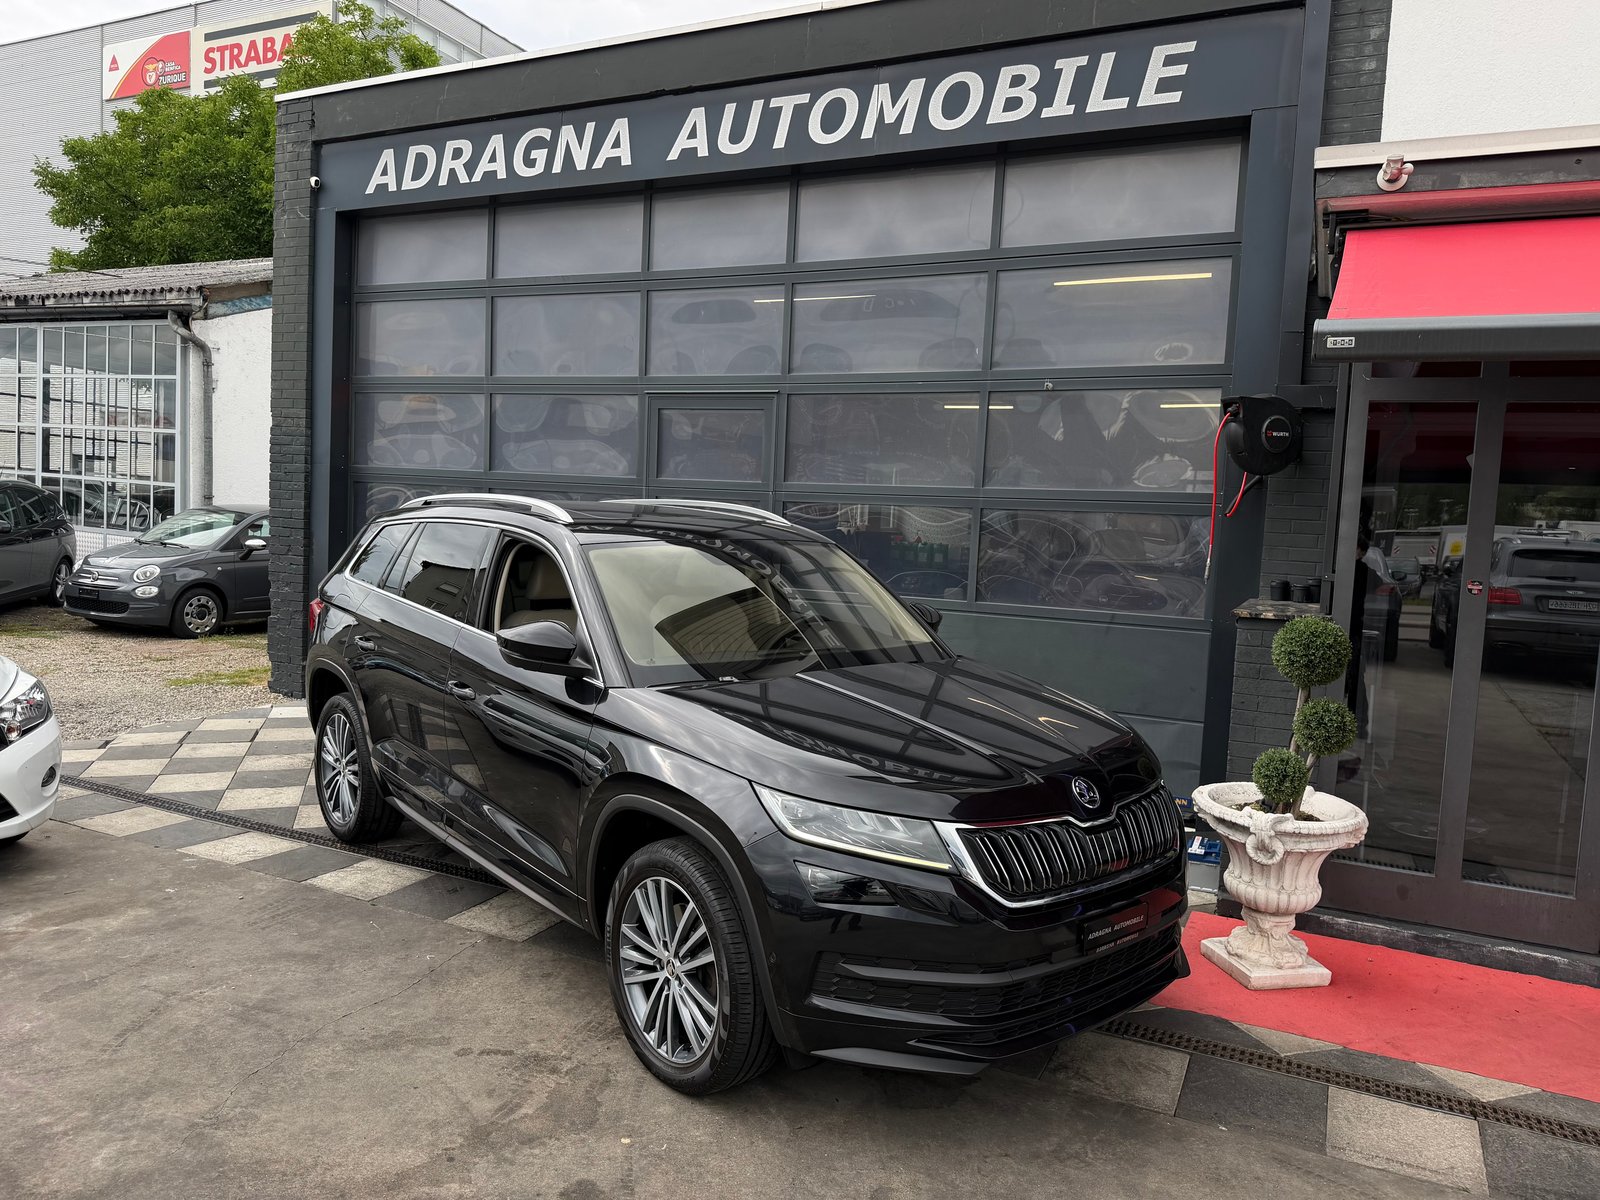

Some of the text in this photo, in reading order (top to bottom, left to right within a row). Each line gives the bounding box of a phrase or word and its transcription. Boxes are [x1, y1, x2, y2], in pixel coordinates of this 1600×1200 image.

[203, 33, 296, 75] STRABA
[159, 72, 187, 85] ZURIQUE
[365, 40, 1197, 194] ADRAGNA AUTOMOBILE
[1088, 915, 1144, 940] ADRAGNA AUTOMOBILE
